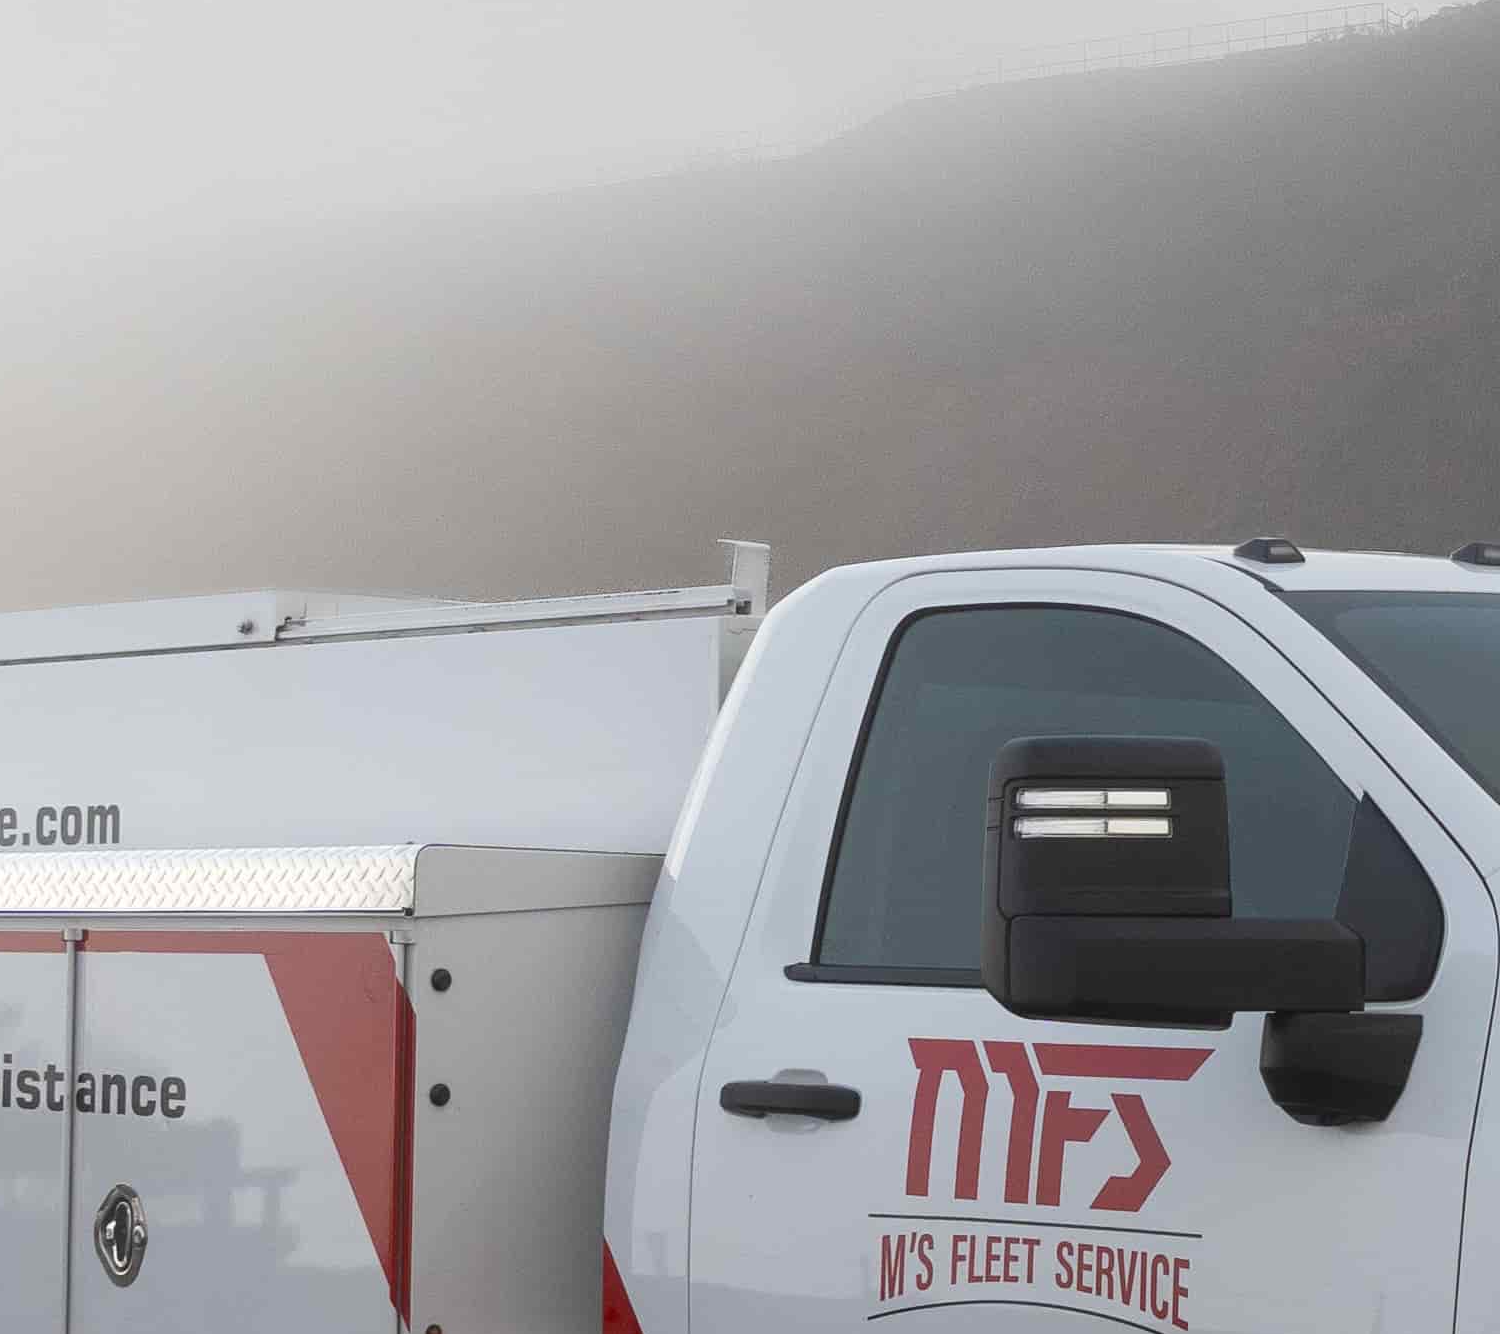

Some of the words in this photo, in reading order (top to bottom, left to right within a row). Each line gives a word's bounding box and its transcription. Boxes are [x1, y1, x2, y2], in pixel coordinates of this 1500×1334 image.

[878, 1232, 935, 1302] M'S
[950, 1234, 1041, 1286] FLEET
[1055, 1240, 1191, 1331] SERVICE
